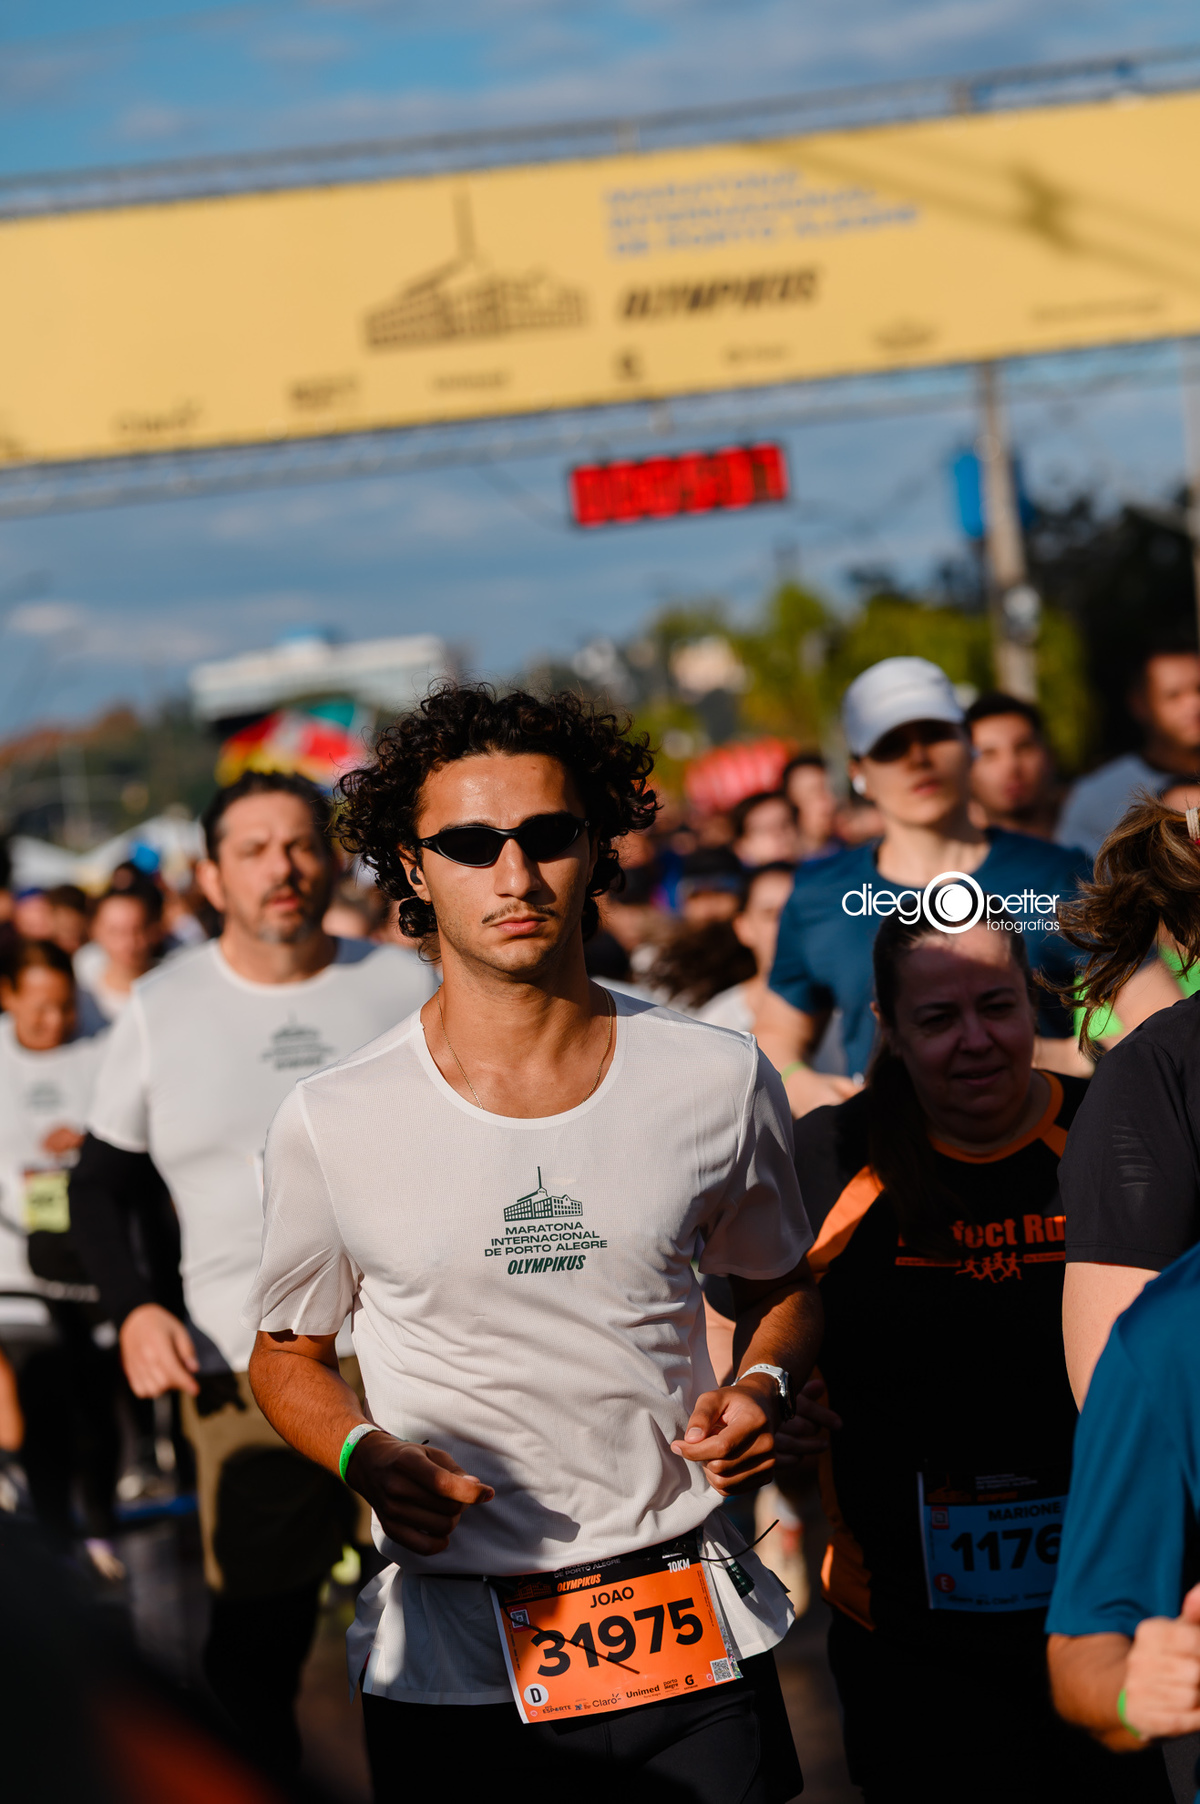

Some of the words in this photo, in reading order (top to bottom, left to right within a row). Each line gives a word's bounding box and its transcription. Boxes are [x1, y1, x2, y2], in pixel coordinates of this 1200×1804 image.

[505, 1221, 584, 1236] MARATONA
[490, 1230, 601, 1247] INTERNACIONAL
[484, 1247, 502, 1257] DE
[505, 1244, 552, 1256] PORTO
[555, 1239, 608, 1252] ALEGRE
[507, 1254, 587, 1275] OLYMPIKUS
[988, 1501, 1062, 1522] MARIONE
[951, 1523, 1063, 1572] 1176
[564, 1565, 592, 1576] PORTO
[592, 1557, 621, 1570] ALEGRE
[667, 1558, 691, 1574] 10KM
[556, 1573, 602, 1593] OLYMPIKUS
[940, 1576, 950, 1592] E
[590, 1586, 635, 1609] JOAO
[530, 1596, 704, 1678] 31975
[530, 1687, 542, 1704] D
[626, 1684, 660, 1699] Unimed
[592, 1697, 618, 1708] Claro
